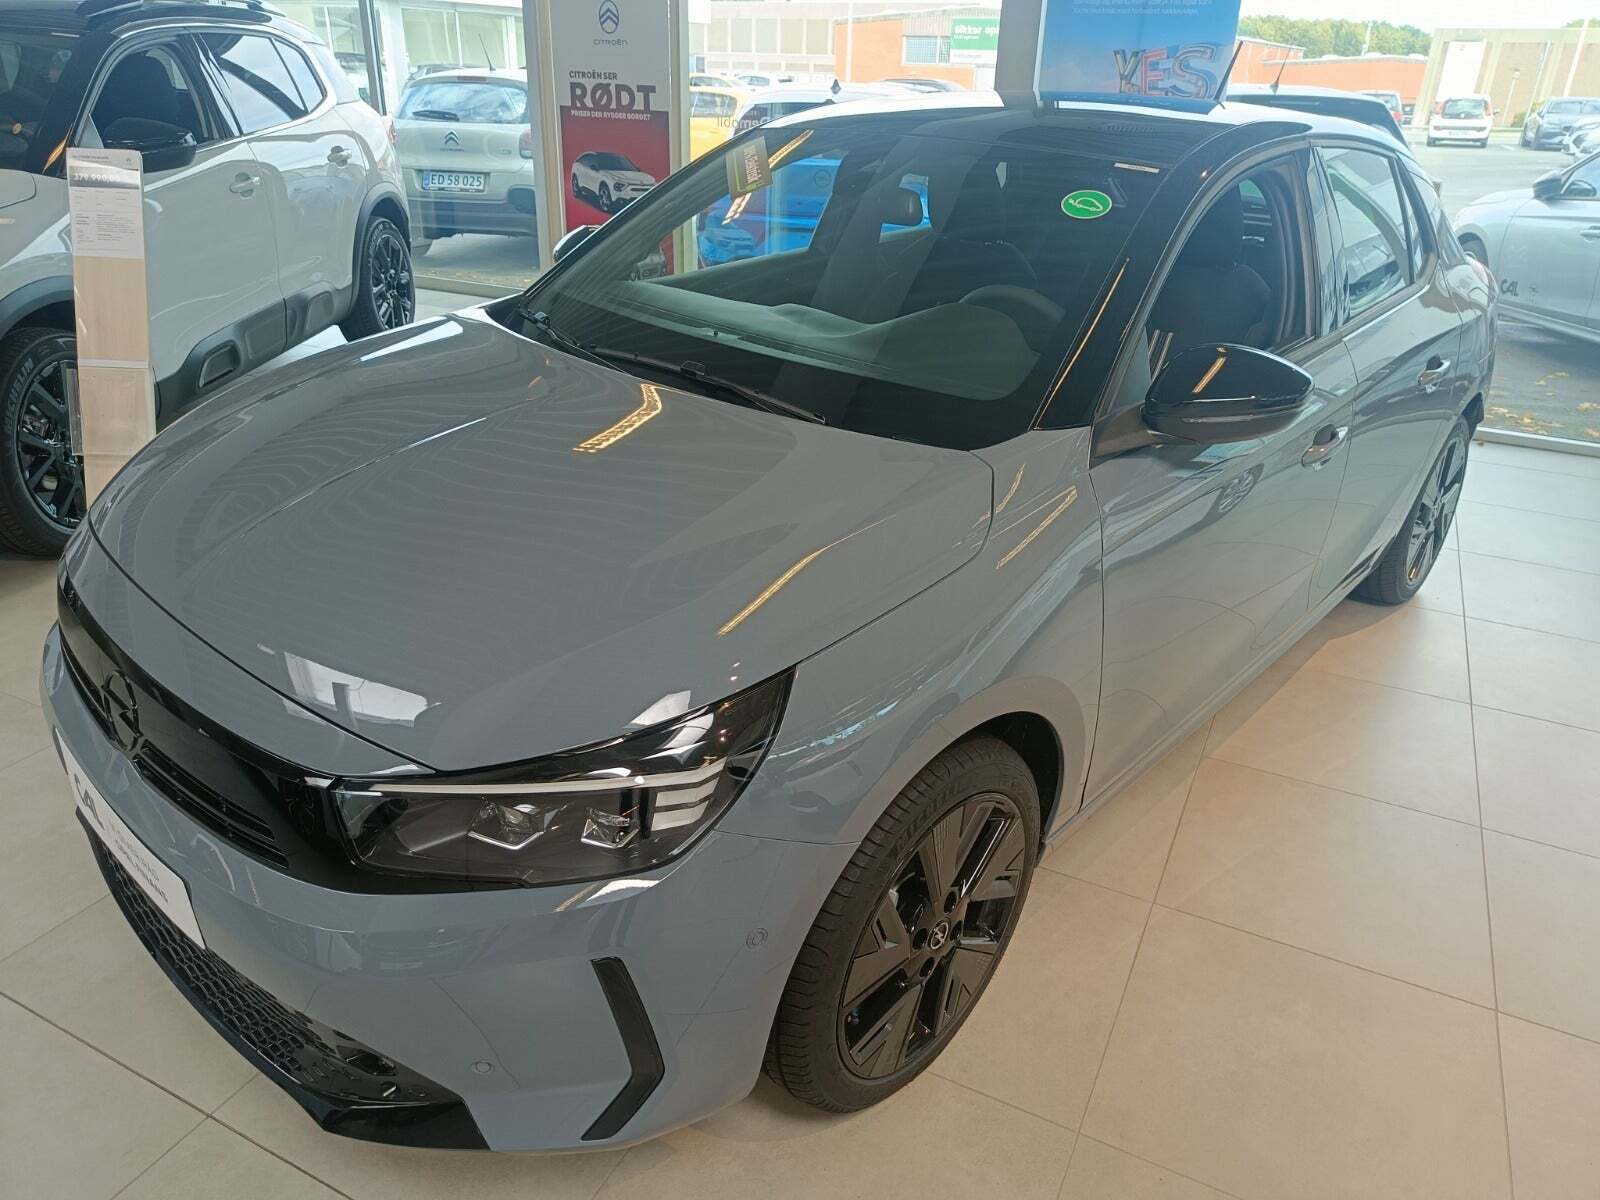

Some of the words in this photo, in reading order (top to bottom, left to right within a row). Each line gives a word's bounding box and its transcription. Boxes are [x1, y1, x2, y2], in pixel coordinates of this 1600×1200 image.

[569, 70, 602, 80] CITROËN
[603, 72, 618, 81] SER
[570, 82, 656, 112] RØDT
[431, 174, 445, 185] ED
[448, 174, 460, 186] 58
[462, 176, 483, 187] 025
